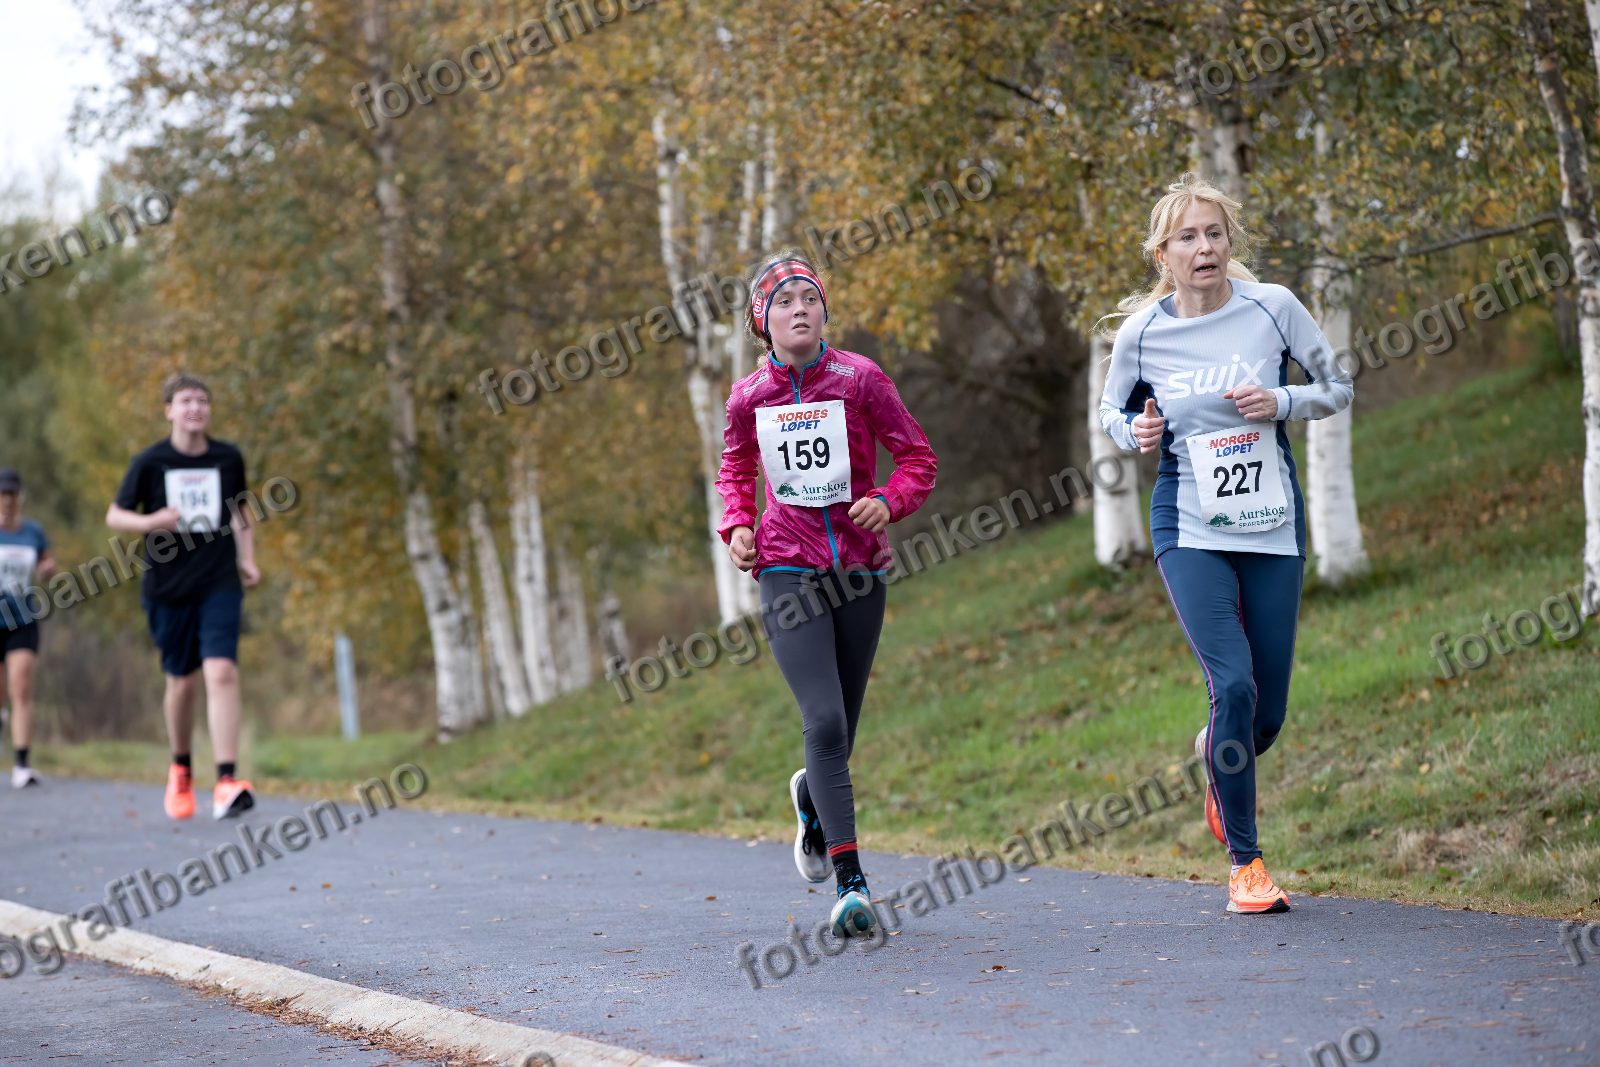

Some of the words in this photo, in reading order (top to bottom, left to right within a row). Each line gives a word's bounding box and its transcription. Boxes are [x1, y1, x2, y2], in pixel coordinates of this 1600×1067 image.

[776, 409, 829, 423] NORGES
[781, 420, 821, 433] LØPET
[1208, 432, 1260, 449] NORGES
[777, 437, 830, 471] 159
[1216, 443, 1254, 458] LØPET
[1213, 461, 1263, 498] 227
[801, 481, 848, 495] Aurskog
[1239, 506, 1285, 520] Aurskog
